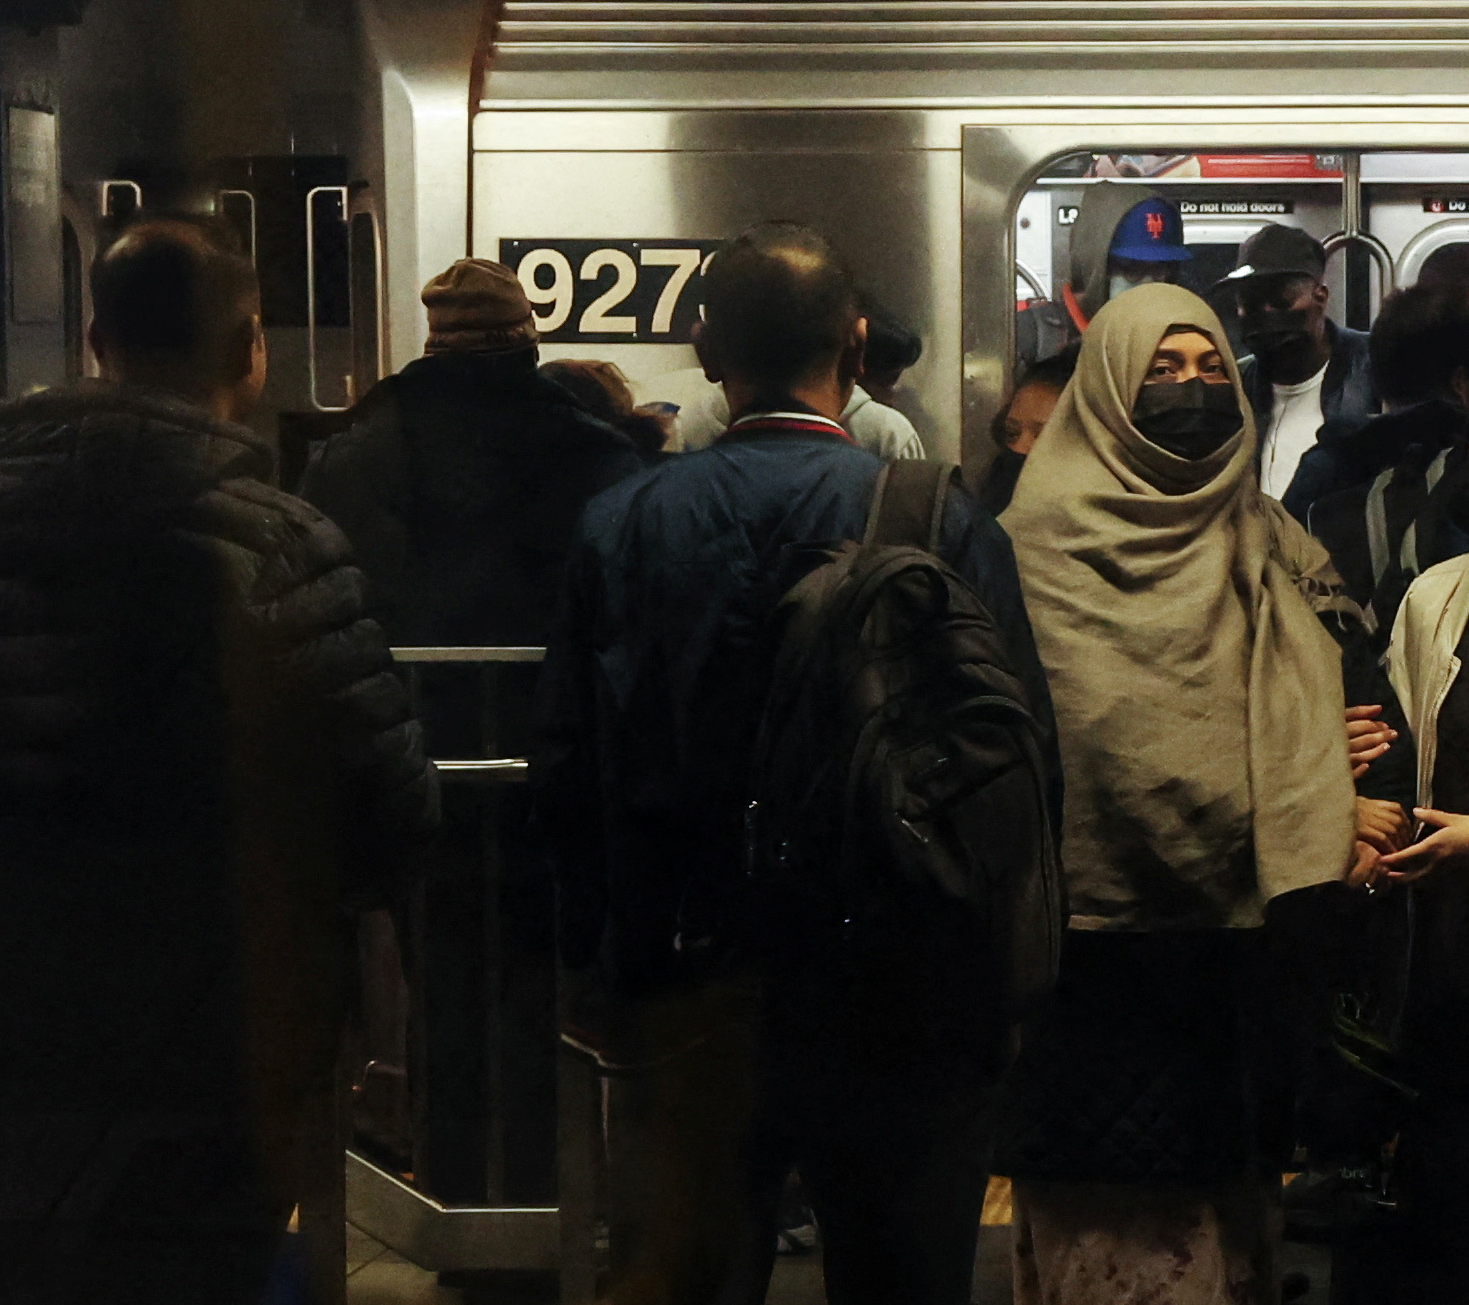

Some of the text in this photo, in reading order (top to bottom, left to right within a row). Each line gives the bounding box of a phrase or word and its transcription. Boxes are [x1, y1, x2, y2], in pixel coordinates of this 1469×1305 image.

[1180, 200, 1285, 213] Do not hold doors
[1448, 200, 1466, 212] Do
[517, 248, 717, 333] 927
